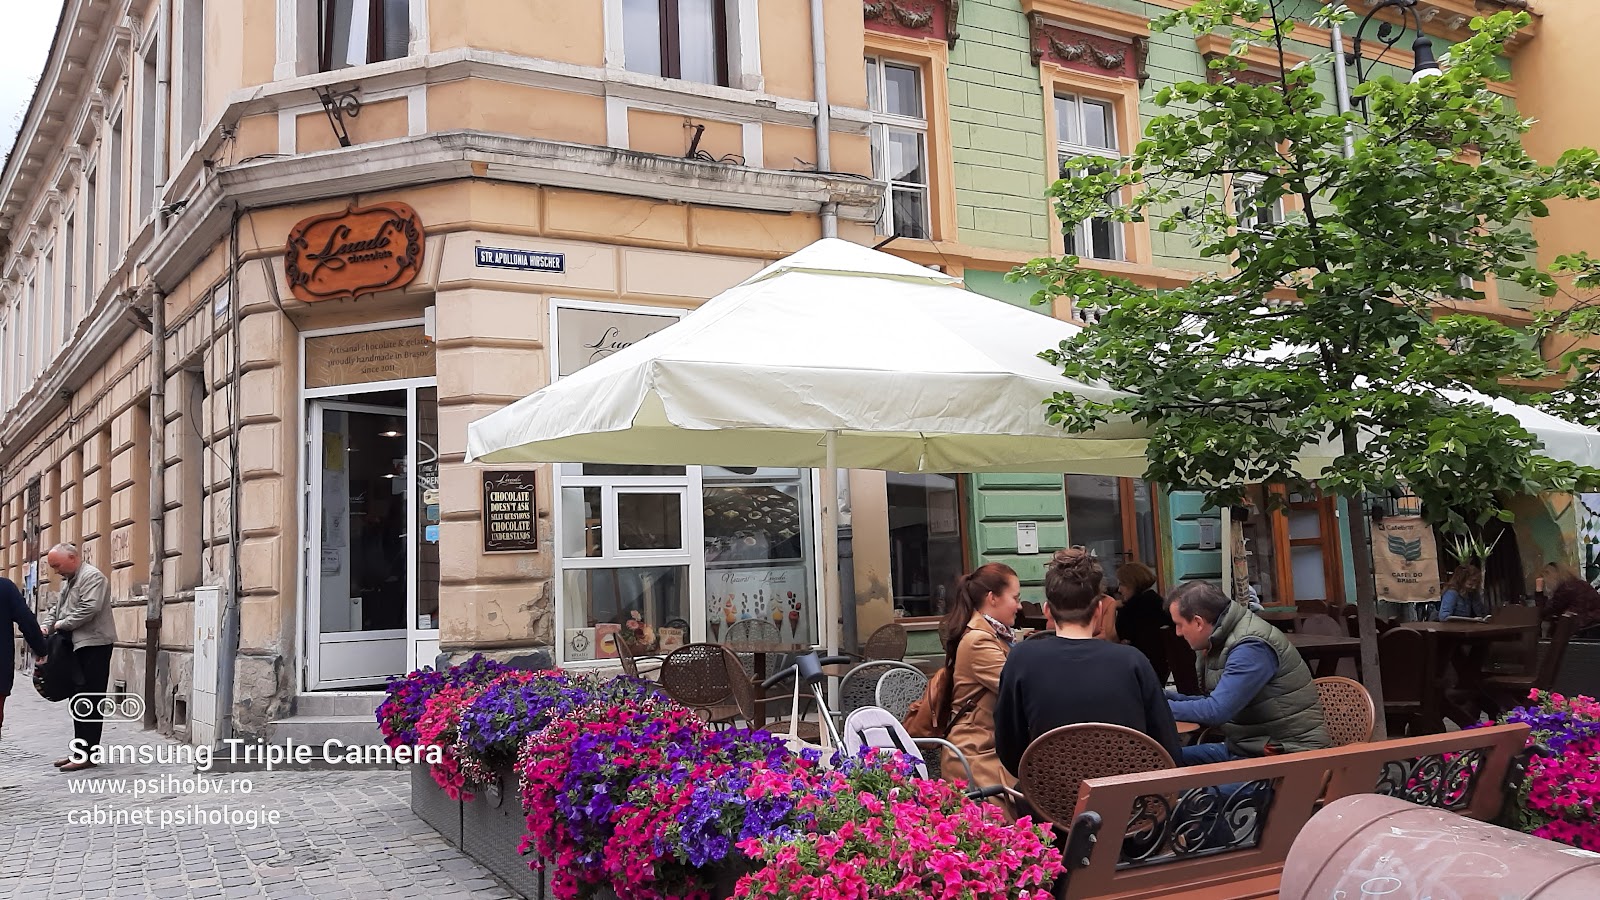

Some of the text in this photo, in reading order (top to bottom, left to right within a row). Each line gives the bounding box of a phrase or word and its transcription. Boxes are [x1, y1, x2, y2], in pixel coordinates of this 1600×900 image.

[347, 249, 393, 264] chocolate
[480, 250, 560, 269] STR. APOLLONIA HIRSCHER
[328, 337, 429, 355] Artisanal chocolate & gelato
[327, 356, 356, 368] proudly
[356, 351, 394, 363] handmade
[395, 351, 403, 360] in
[361, 363, 395, 375] since 2011
[490, 491, 530, 502] CHOCOLATE
[490, 502, 530, 512] DOESN'T ASK
[504, 512, 531, 520] QUESTIONS
[491, 520, 531, 532] CHOCOLATE
[491, 531, 531, 541] UNDERSTANDS
